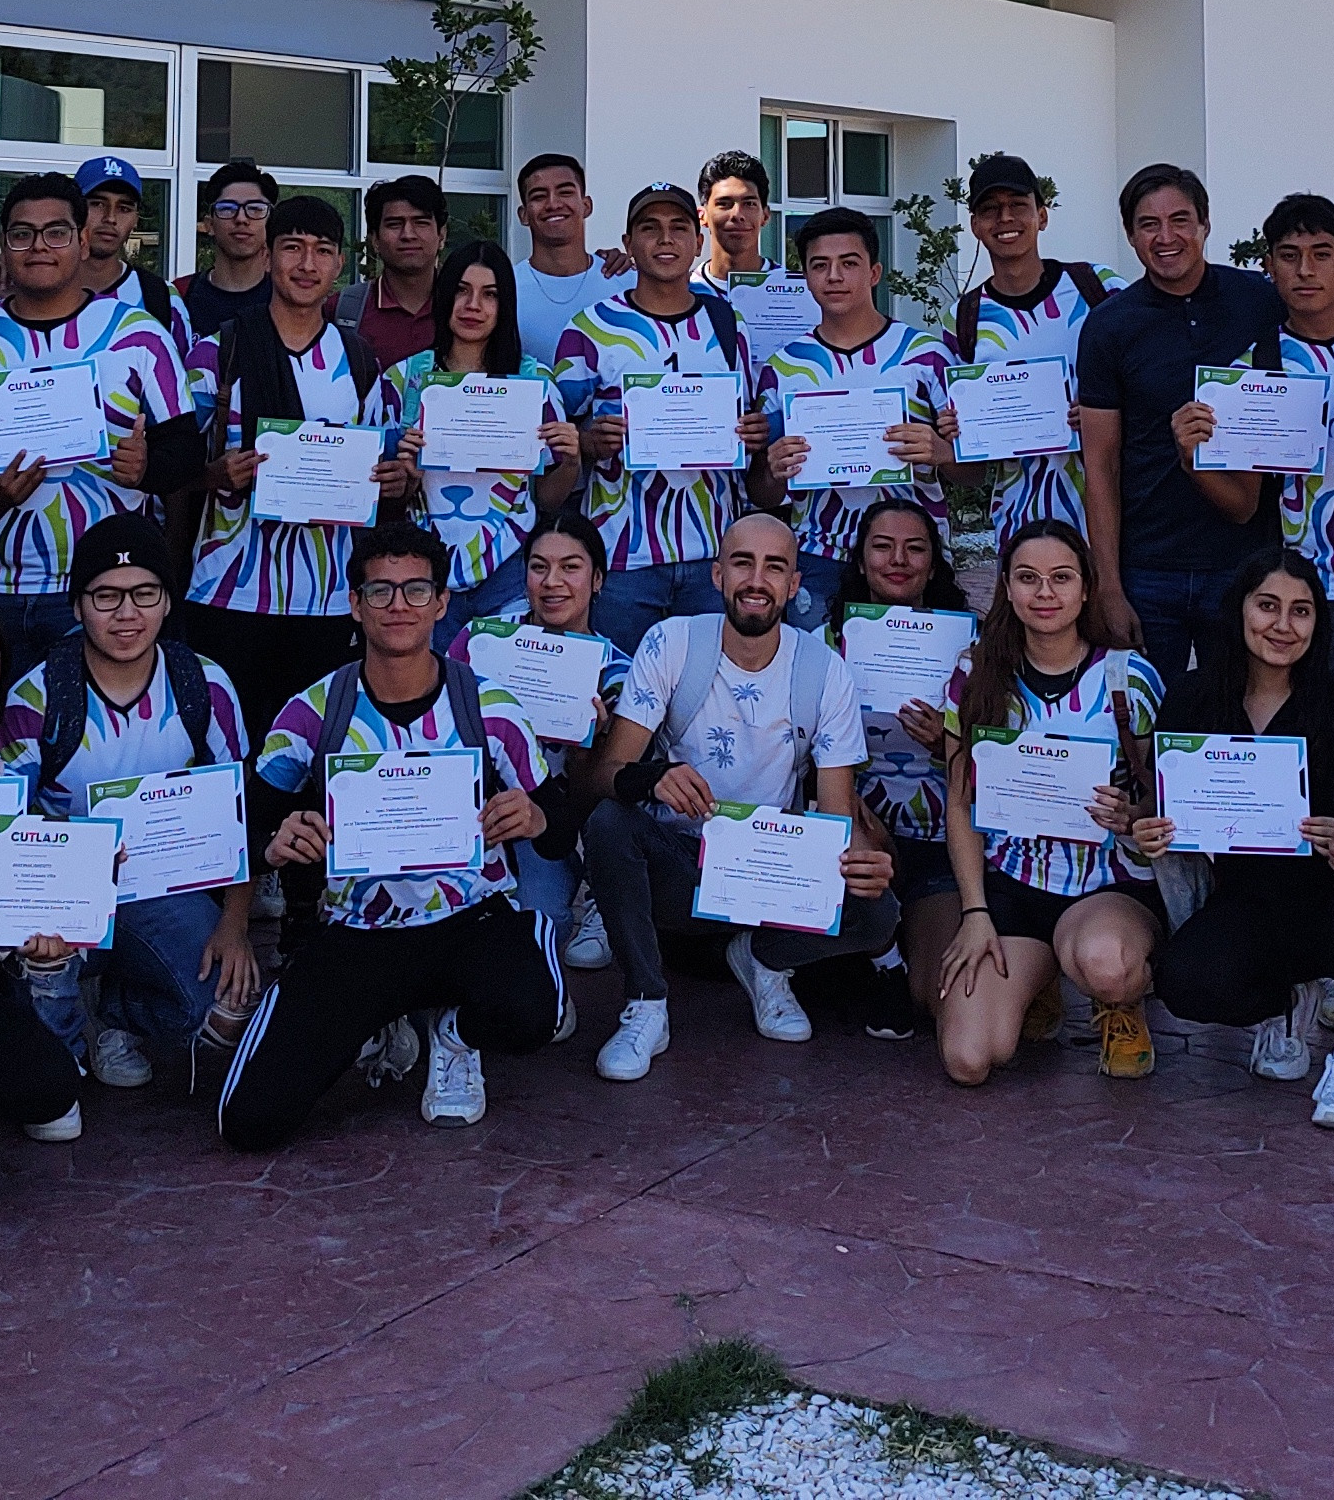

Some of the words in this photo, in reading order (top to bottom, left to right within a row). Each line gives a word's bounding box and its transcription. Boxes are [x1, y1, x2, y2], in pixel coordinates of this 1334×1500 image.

[104, 158, 123, 177] LA
[663, 351, 679, 373] 1
[986, 371, 1029, 383] CUTLAJO
[8, 379, 55, 391] CUTLAJO
[462, 385, 507, 395] CUTLAJO
[661, 385, 703, 394] CUTLAJO
[1240, 383, 1288, 394] CUTLAJO
[298, 433, 345, 445] CUTLAJO
[885, 619, 934, 631] CUTLAJO
[514, 638, 564, 654] CUTLAJO
[1018, 744, 1069, 758] CUTLAJO
[1204, 750, 1256, 761] CUTLAJO
[378, 766, 431, 778] CUTLAJO
[139, 785, 193, 802] CUTLAJO
[752, 820, 804, 836] CUTLAJO
[10, 831, 69, 843] CUTLAJO
